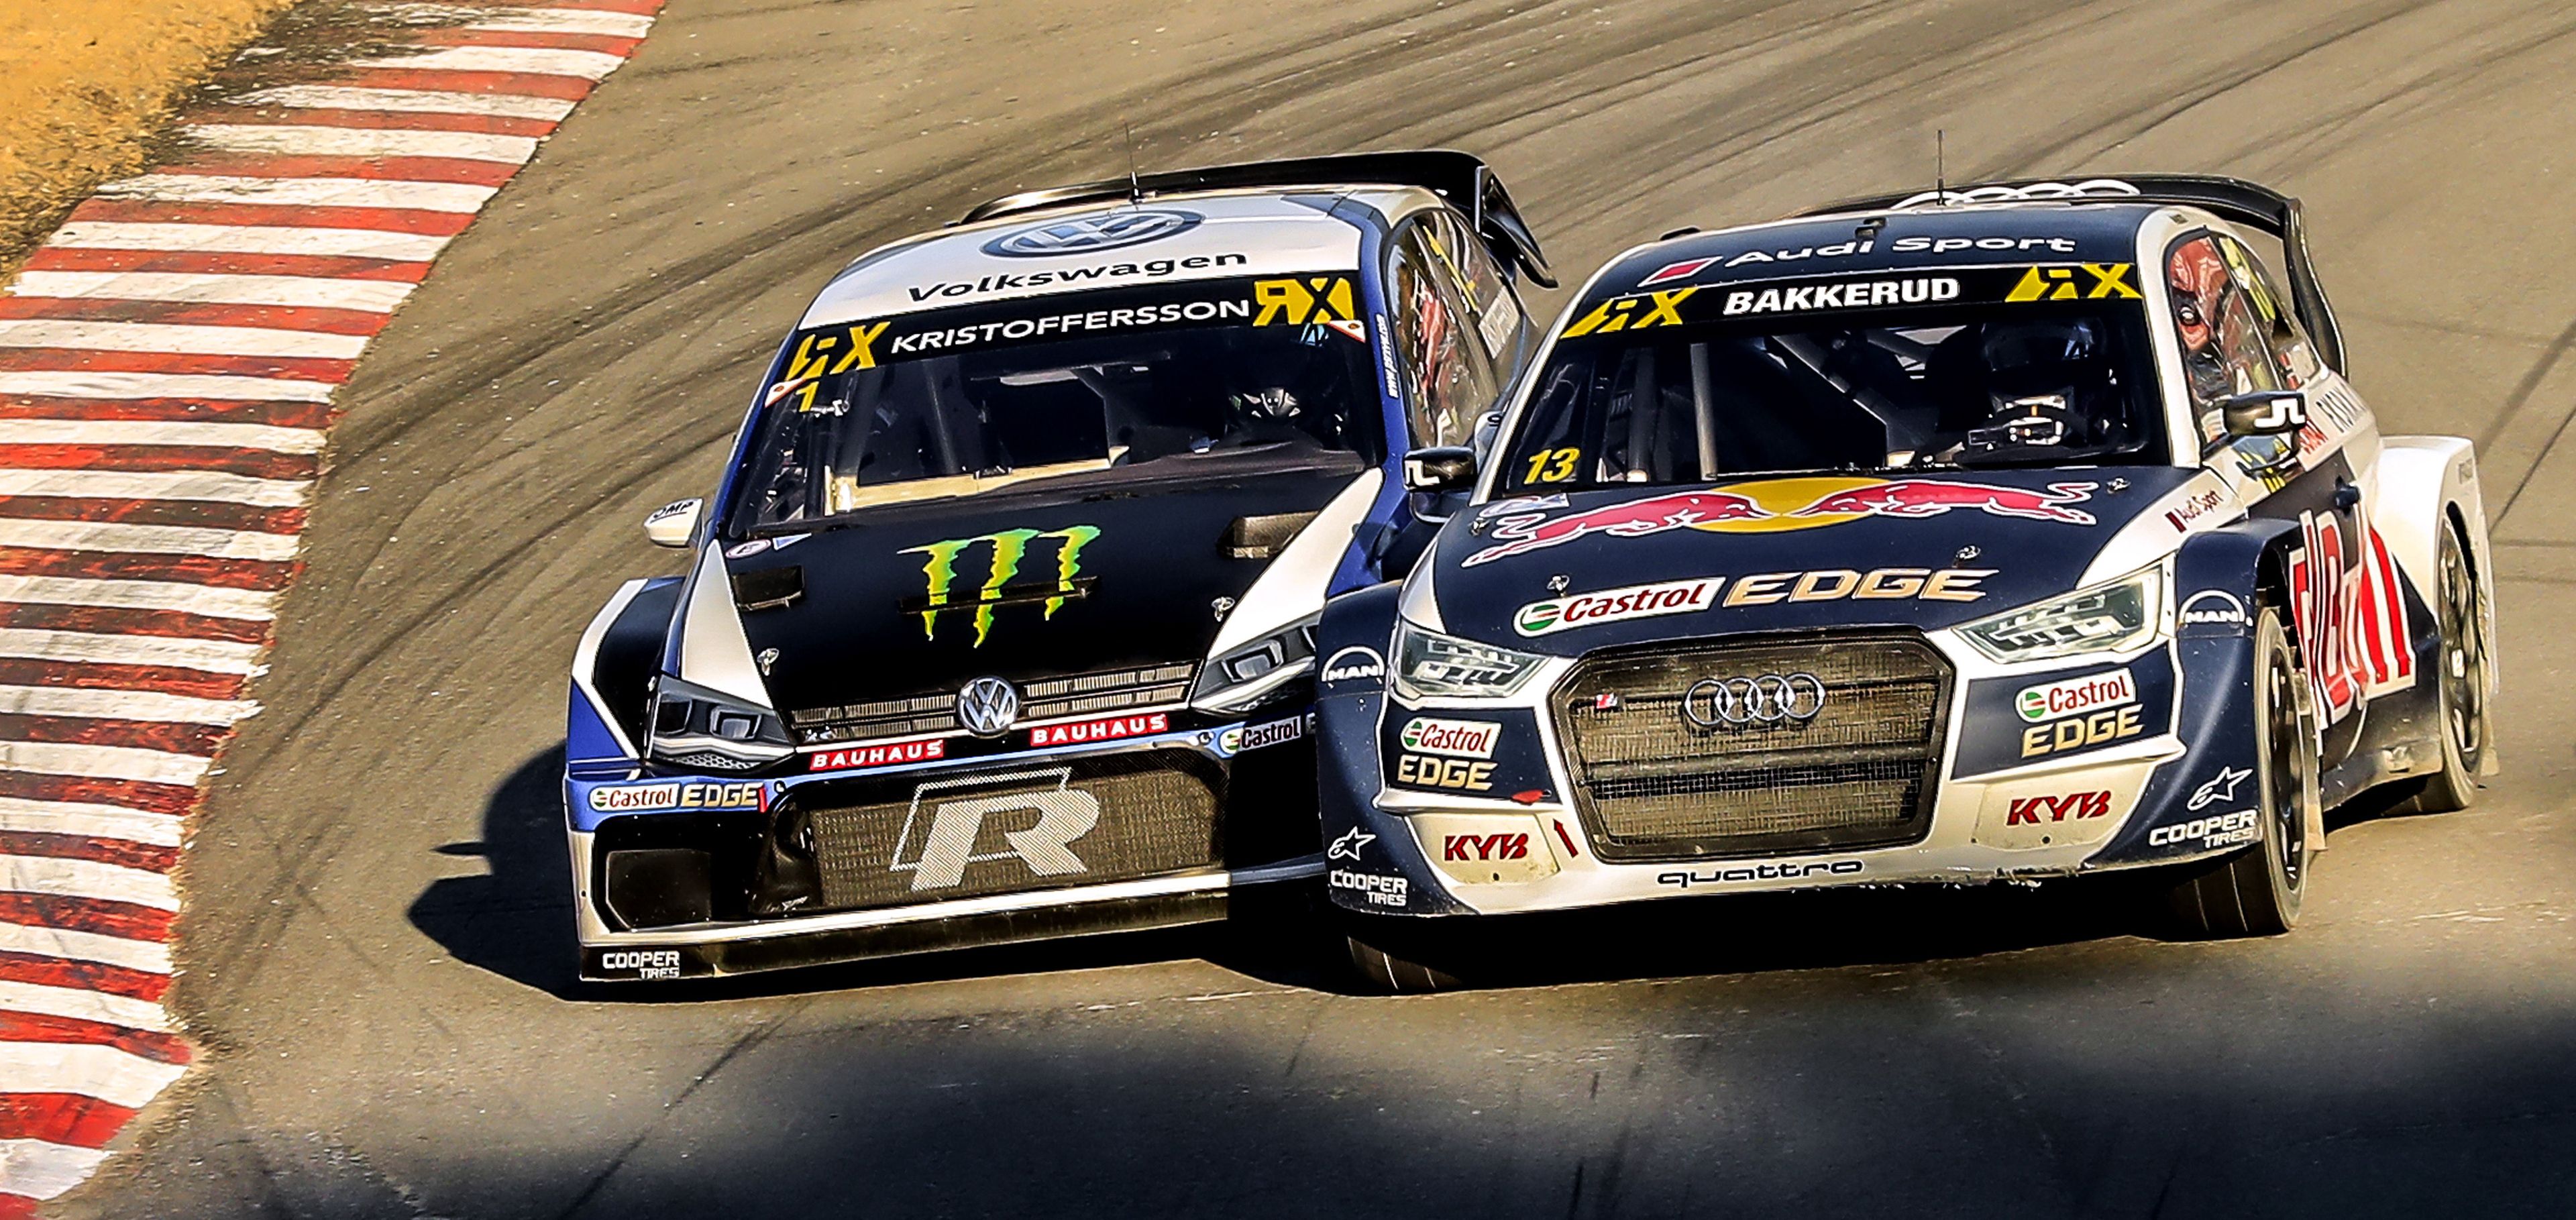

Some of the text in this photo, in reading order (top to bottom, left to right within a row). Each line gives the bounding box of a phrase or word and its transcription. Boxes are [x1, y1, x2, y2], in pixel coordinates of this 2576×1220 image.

[1724, 237, 2078, 268] Audi Sport
[908, 250, 1248, 304] Volkswagen
[1722, 278, 1960, 317] BAKKERUD
[890, 299, 1251, 355] KRISTOFFERSSON
[796, 381, 820, 412] 1
[1523, 445, 1581, 486] 13
[1563, 568, 2000, 624] Castrol EDGE
[2185, 610, 2237, 623] MAN
[1329, 665, 1377, 680] MAN
[2048, 675, 2129, 714] Castrol
[1032, 715, 1166, 744] BAUHAUS
[1242, 718, 1300, 748] Castrol
[1421, 724, 1492, 754] Castrol
[2021, 704, 2144, 759] EDGE
[812, 741, 941, 769] BAUHAUS
[1397, 755, 1499, 791] EDGE
[609, 783, 765, 807] Castrol EDGE
[2006, 790, 2112, 826] KYB
[911, 788, 1100, 892] R
[2149, 809, 2258, 846] COOPER
[2203, 829, 2255, 848] TIRES
[1444, 833, 1529, 861] KYB
[1331, 870, 1407, 894] COOPER
[1657, 860, 1864, 888] quattro
[1366, 893, 1406, 907] TIRES
[602, 951, 680, 969] COOPER
[639, 967, 680, 979] TIRES
